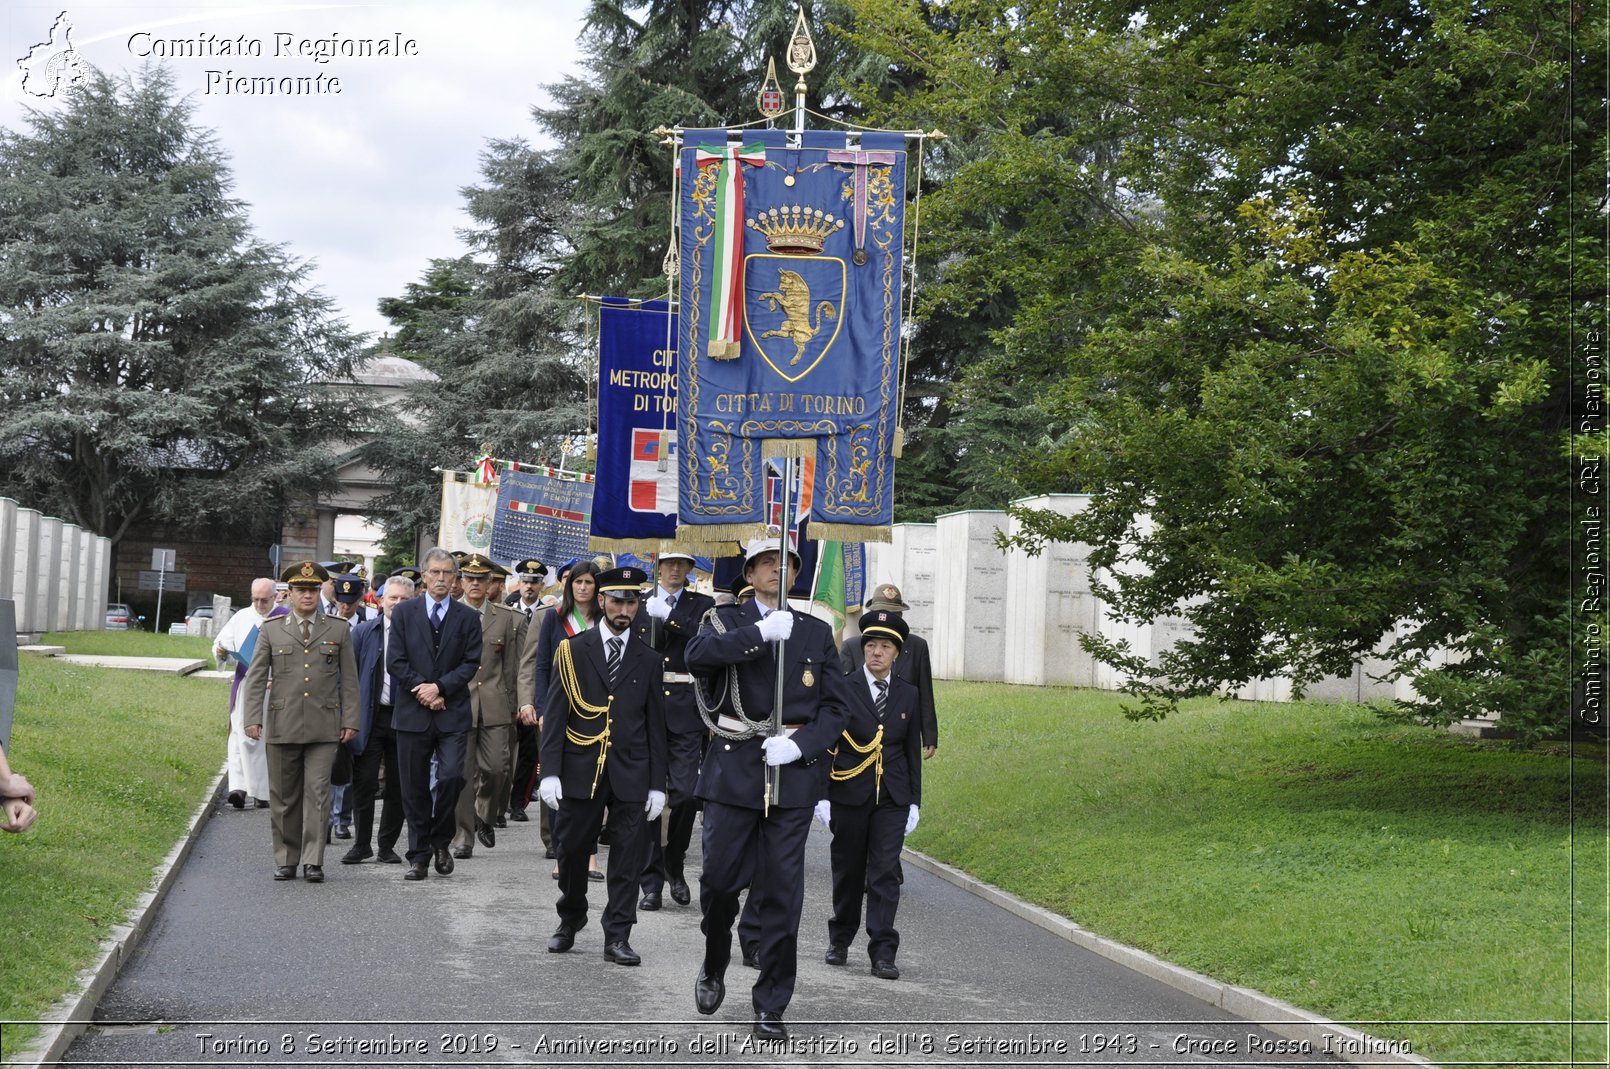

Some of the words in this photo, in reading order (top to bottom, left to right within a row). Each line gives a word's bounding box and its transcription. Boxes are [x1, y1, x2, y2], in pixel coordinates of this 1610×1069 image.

[653, 349, 678, 367] CIT
[634, 394, 649, 412] DI
[779, 393, 794, 412] DI
[801, 394, 865, 415] TORINO
[543, 493, 580, 505] PIEMONTE
